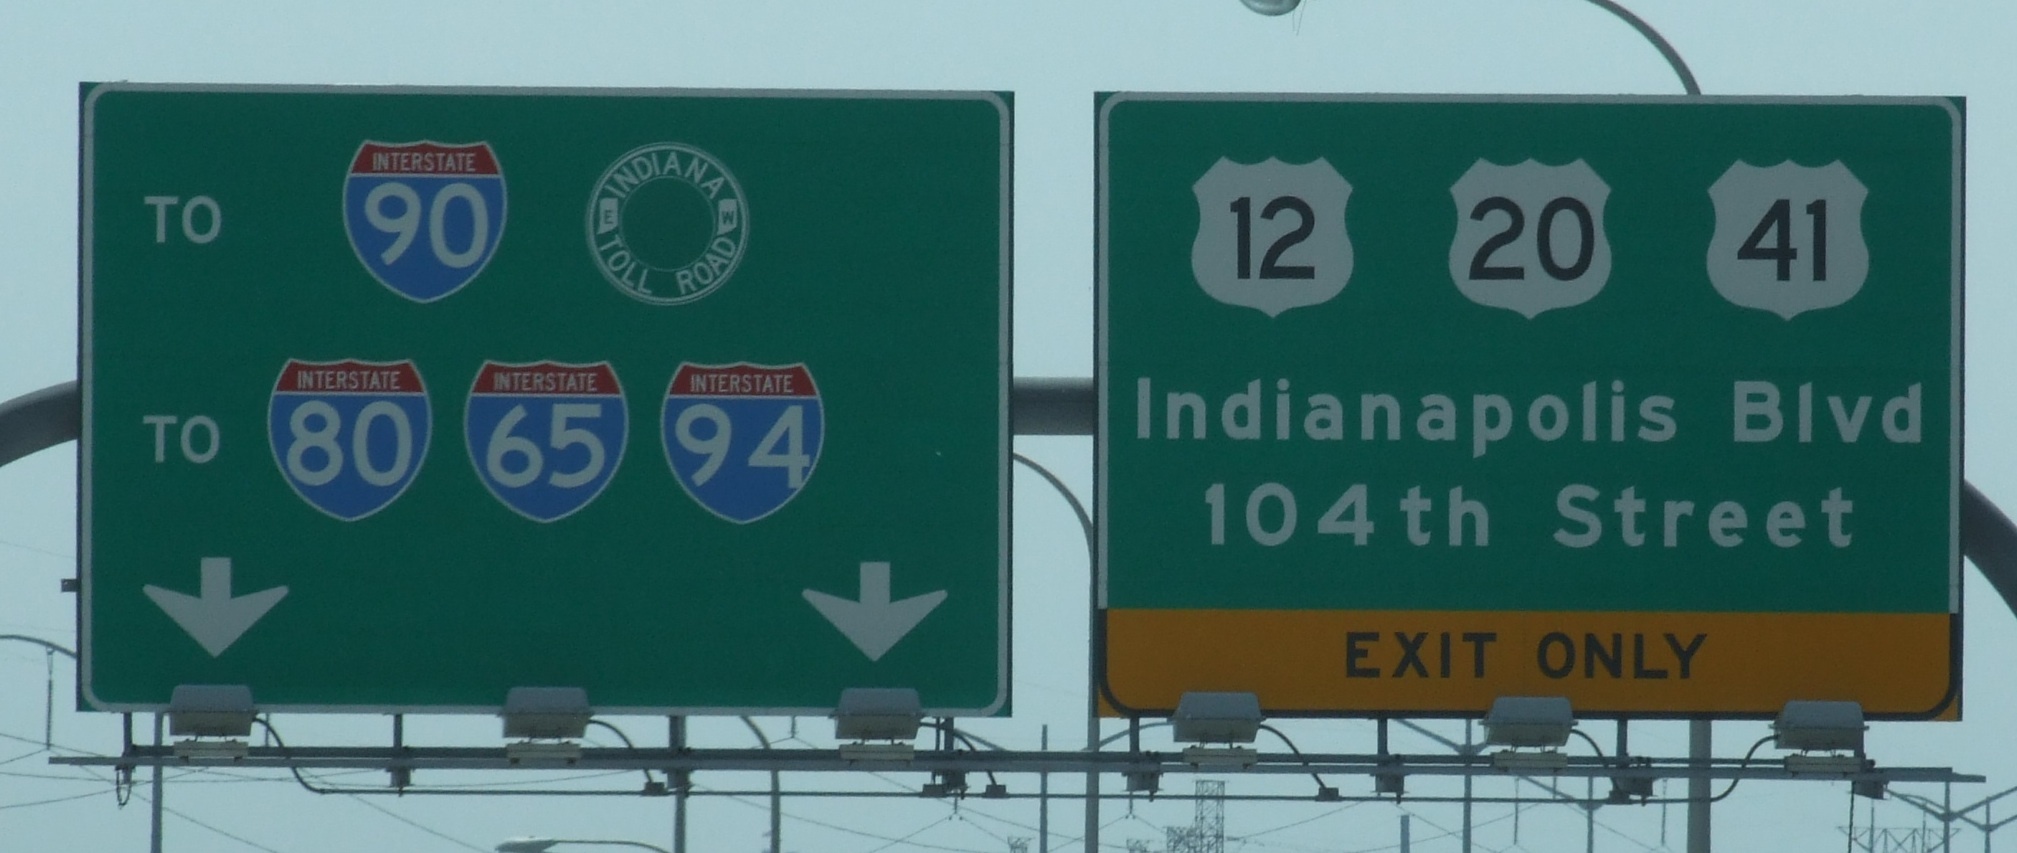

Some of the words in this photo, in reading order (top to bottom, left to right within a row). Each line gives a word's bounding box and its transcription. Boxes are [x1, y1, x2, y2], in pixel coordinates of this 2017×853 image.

[373, 151, 477, 172] INTERSTATE
[604, 151, 725, 199] INDIANA
[144, 195, 222, 243] TO
[364, 182, 489, 268] 90
[604, 210, 613, 224] E
[722, 211, 735, 225] W
[1229, 195, 1317, 280] 12
[1468, 196, 1596, 282] 20
[1737, 198, 1828, 282] 41
[599, 234, 653, 294] TOLL
[675, 236, 737, 295] ROAD
[297, 370, 401, 391] INTERSTATE
[493, 372, 598, 392] INTERSTATE
[690, 373, 795, 393] INTERSTATE
[143, 414, 221, 464] TO
[286, 399, 413, 487] 80
[486, 402, 606, 488] 65
[1136, 377, 1677, 458] Indianapolis
[1733, 380, 1923, 444] Blvd
[675, 402, 811, 489] 94
[1205, 482, 1490, 547] 104th
[1553, 484, 1855, 548] Street
[1346, 631, 1498, 680] EXIT
[1537, 632, 1708, 681] ONLY
